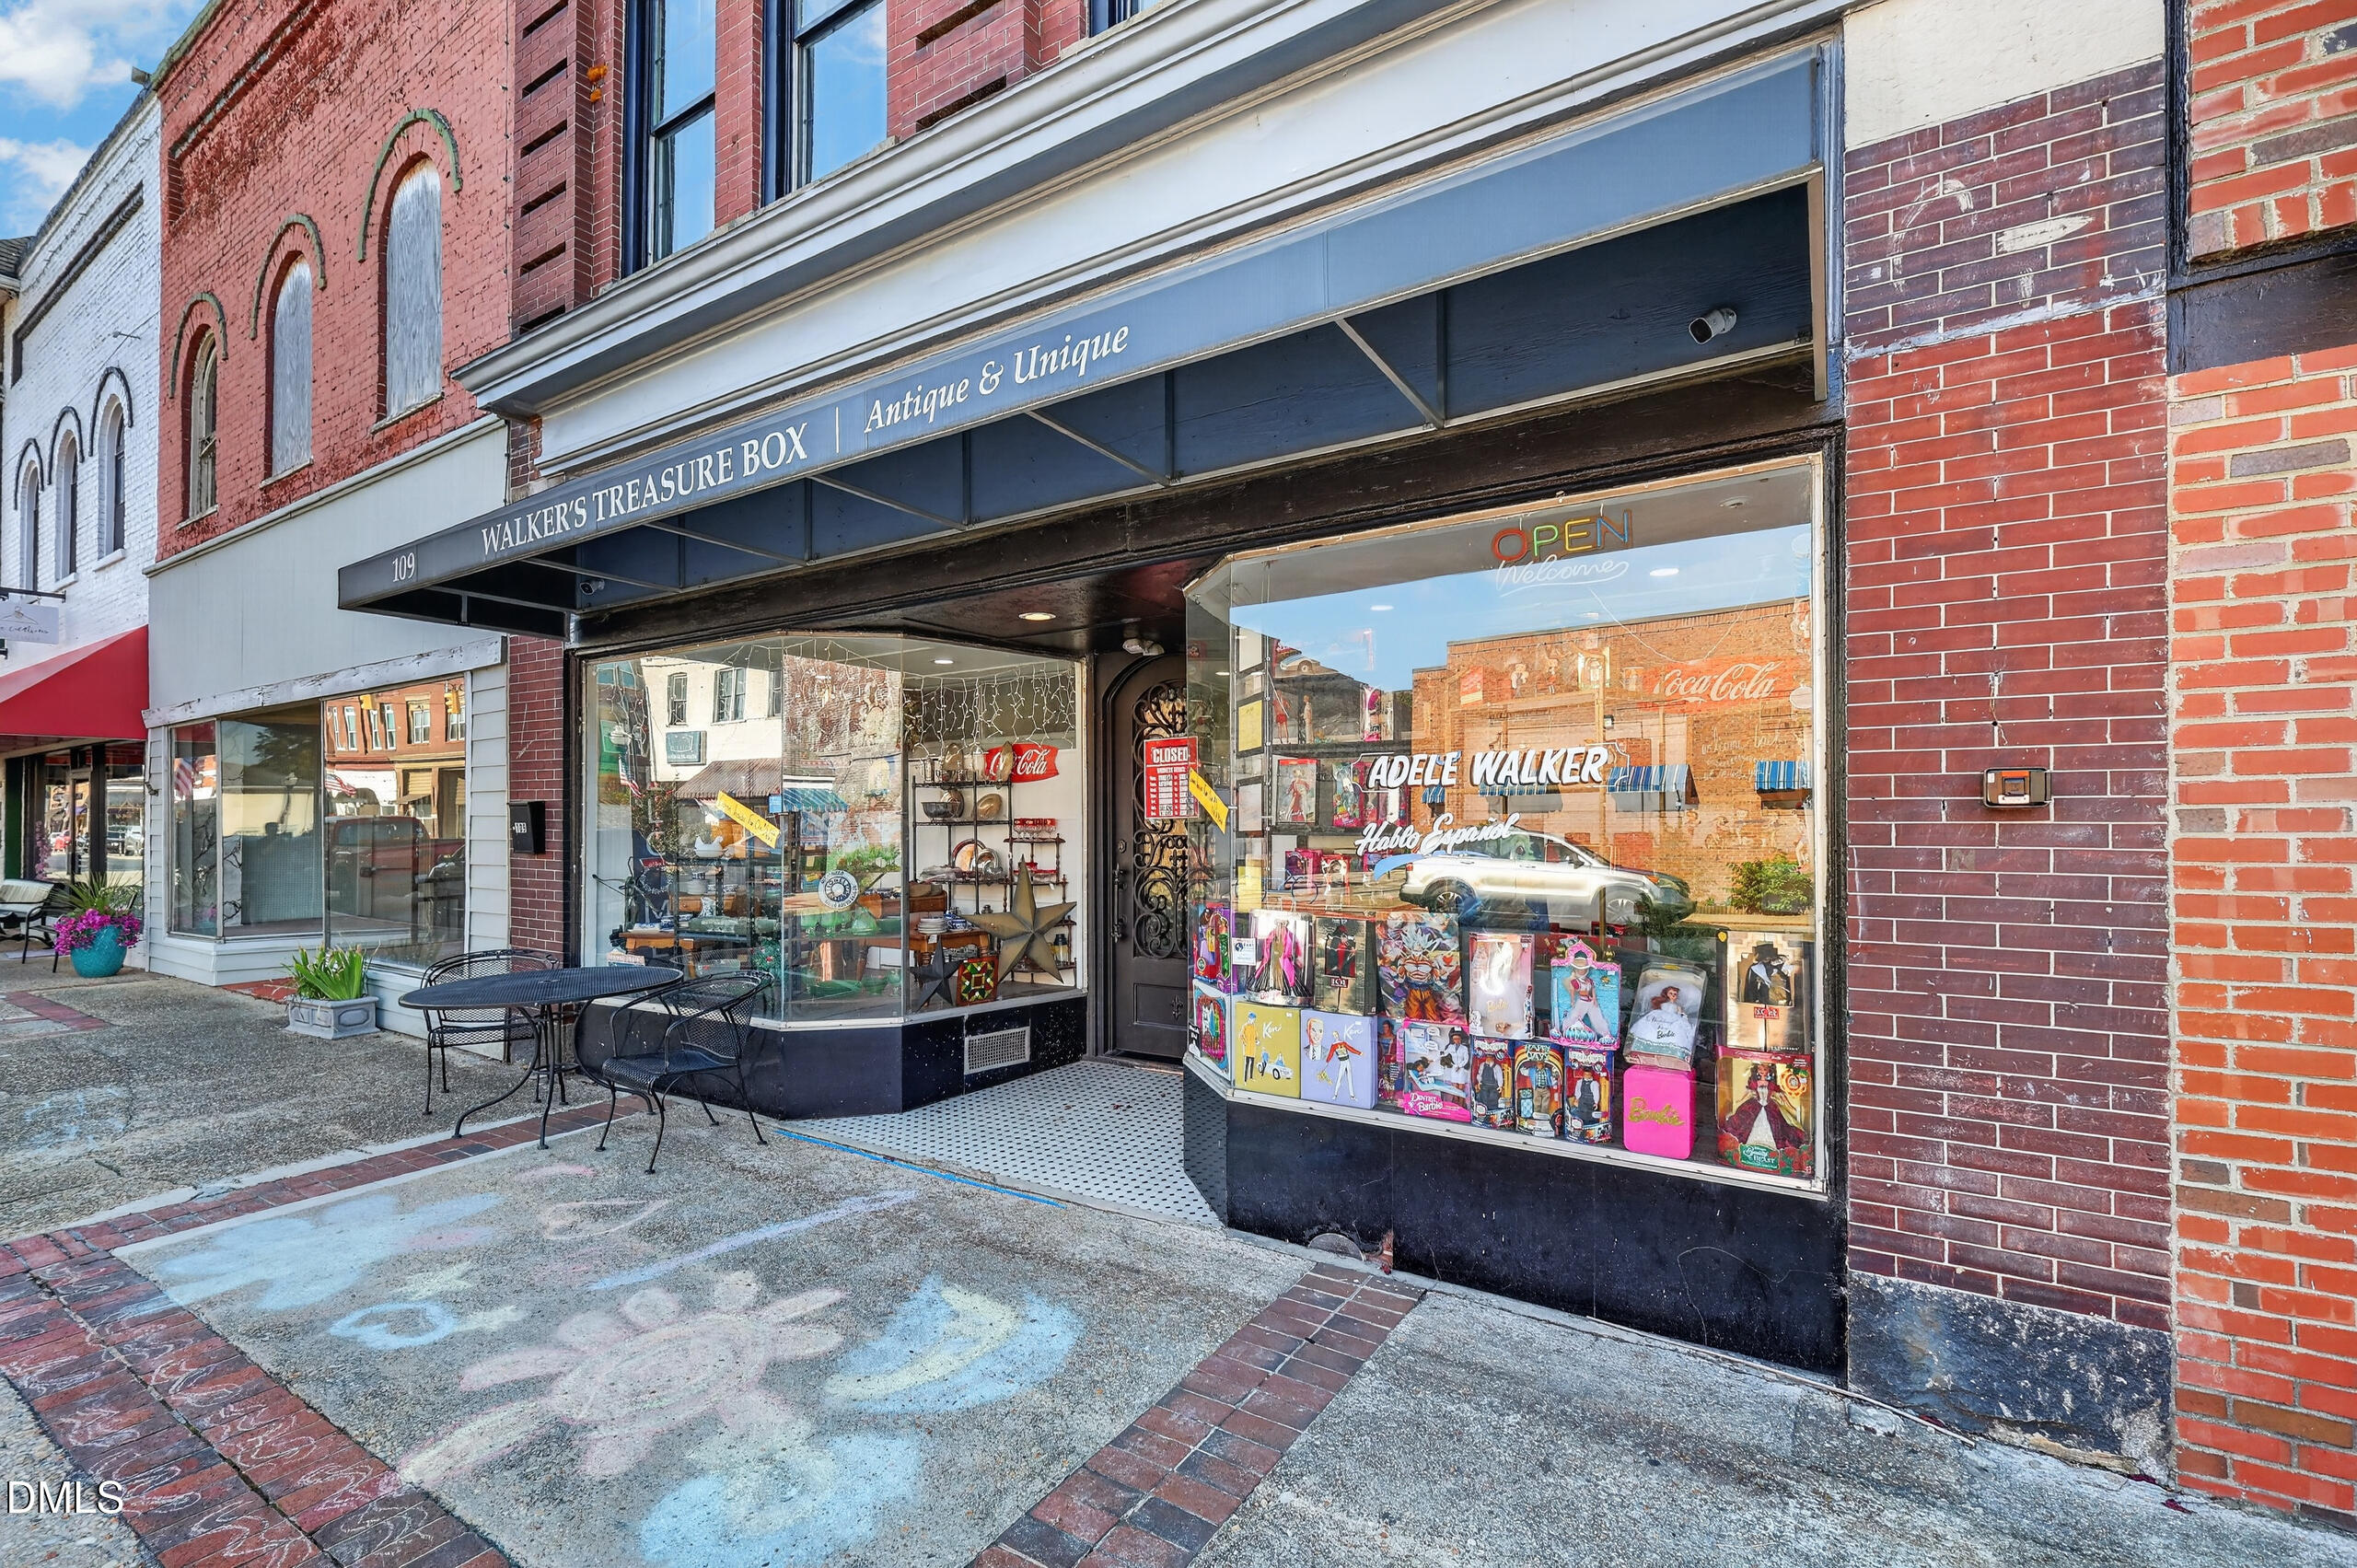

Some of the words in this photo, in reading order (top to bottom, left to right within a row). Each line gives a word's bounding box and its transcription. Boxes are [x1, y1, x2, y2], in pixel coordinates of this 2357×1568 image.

[864, 377, 970, 434] Antique
[979, 360, 1004, 396] &
[1014, 325, 1129, 377] Unique
[482, 495, 587, 554] WALKER'S
[592, 447, 734, 522] TREASURE
[740, 423, 807, 477] BOX
[1492, 509, 1631, 562] OPEN
[392, 552, 415, 582] 109
[1496, 554, 1630, 592] Welcome
[1152, 747, 1189, 763] CLOSED
[1368, 750, 1462, 787] ADELE
[1471, 746, 1609, 786] WALKER
[1355, 819, 1422, 856] Hablo
[1419, 812, 1520, 855] Español
[1262, 1021, 1282, 1039] Ken
[1628, 1097, 1686, 1126] Barbie
